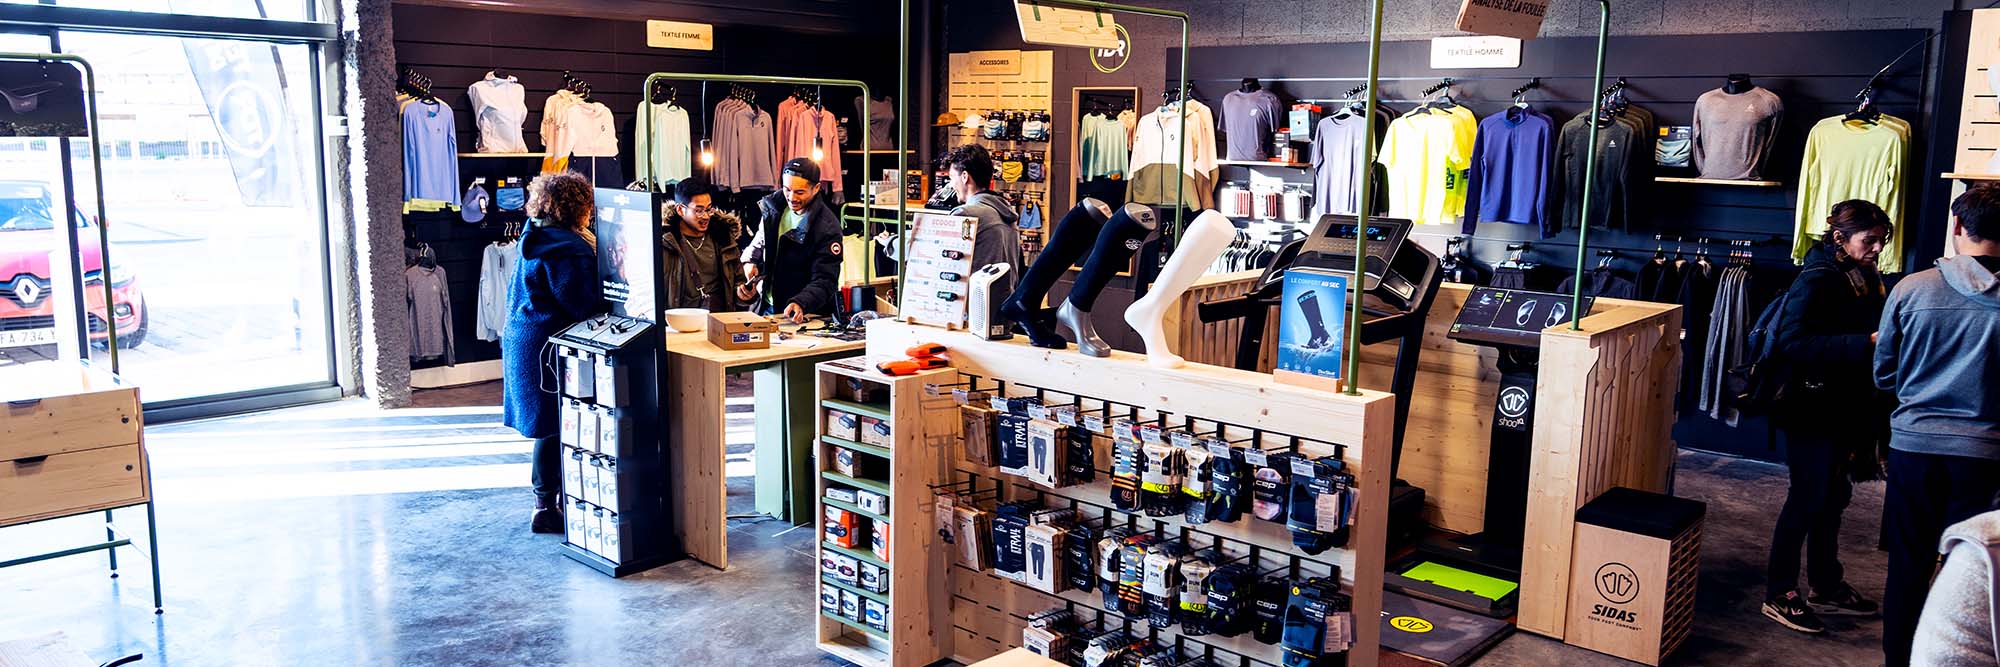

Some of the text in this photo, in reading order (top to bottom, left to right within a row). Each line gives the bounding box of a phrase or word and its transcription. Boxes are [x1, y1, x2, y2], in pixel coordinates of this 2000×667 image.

[1504, 0, 1515, 11] DE
[1521, 2, 1546, 17] FOULÉE
[661, 31, 701, 40] TEXTILE FEMME
[1475, 48, 1504, 56] HOMME
[1212, 471, 1231, 482] cep
[1255, 479, 1277, 490] cep
[1207, 590, 1229, 602] cep
[1256, 599, 1279, 610] cep
[1592, 604, 1637, 623] SIDAS
